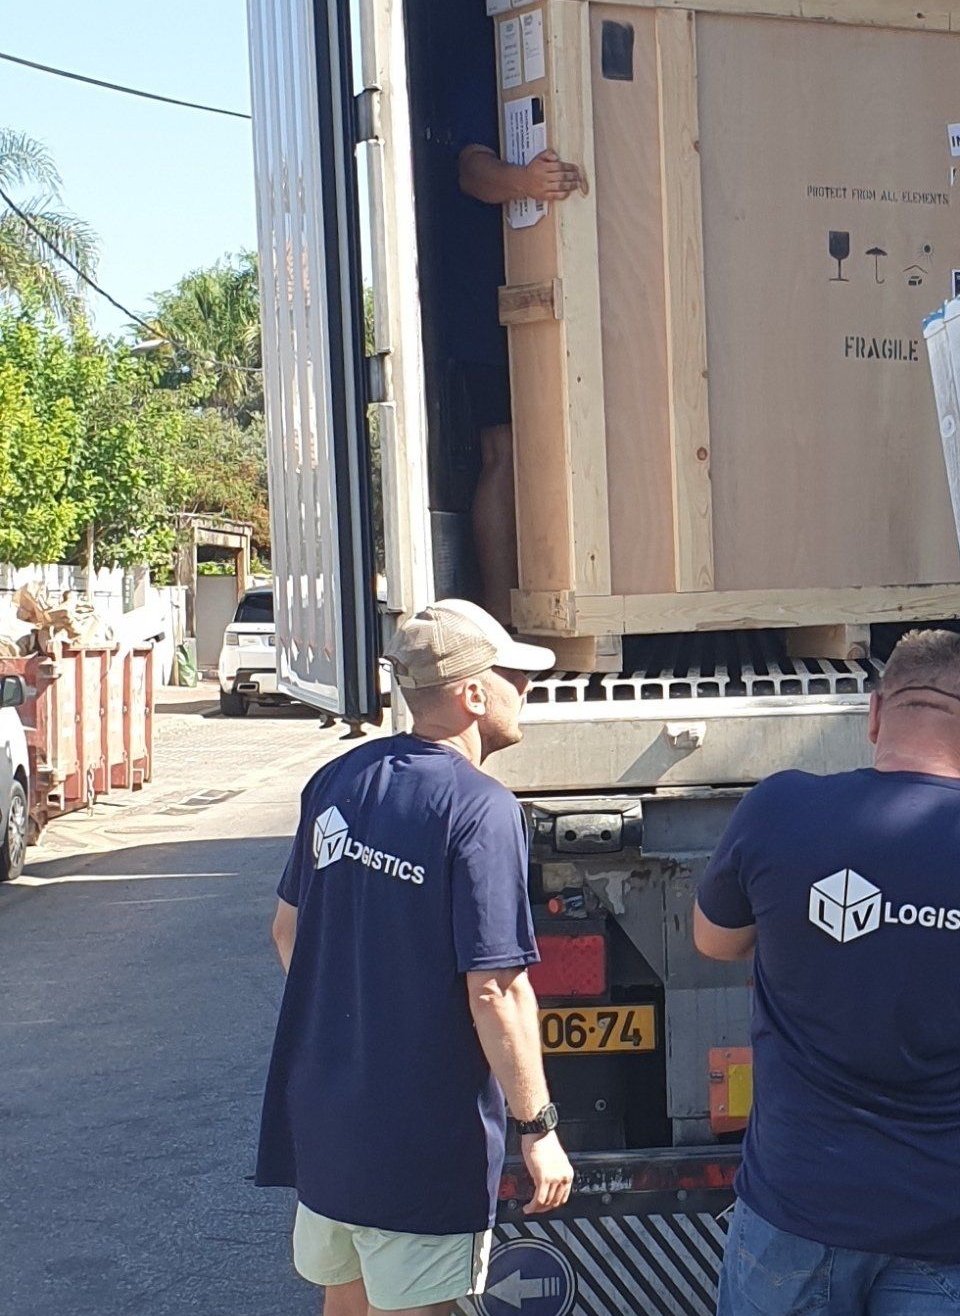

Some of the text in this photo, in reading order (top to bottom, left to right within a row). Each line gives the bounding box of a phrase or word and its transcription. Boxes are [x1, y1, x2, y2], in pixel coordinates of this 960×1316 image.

[807, 185, 950, 205] PROTECT FROM ALL ELEMENTS
[844, 336, 919, 362] FRAGILE
[343, 837, 426, 885] LOGISTICS
